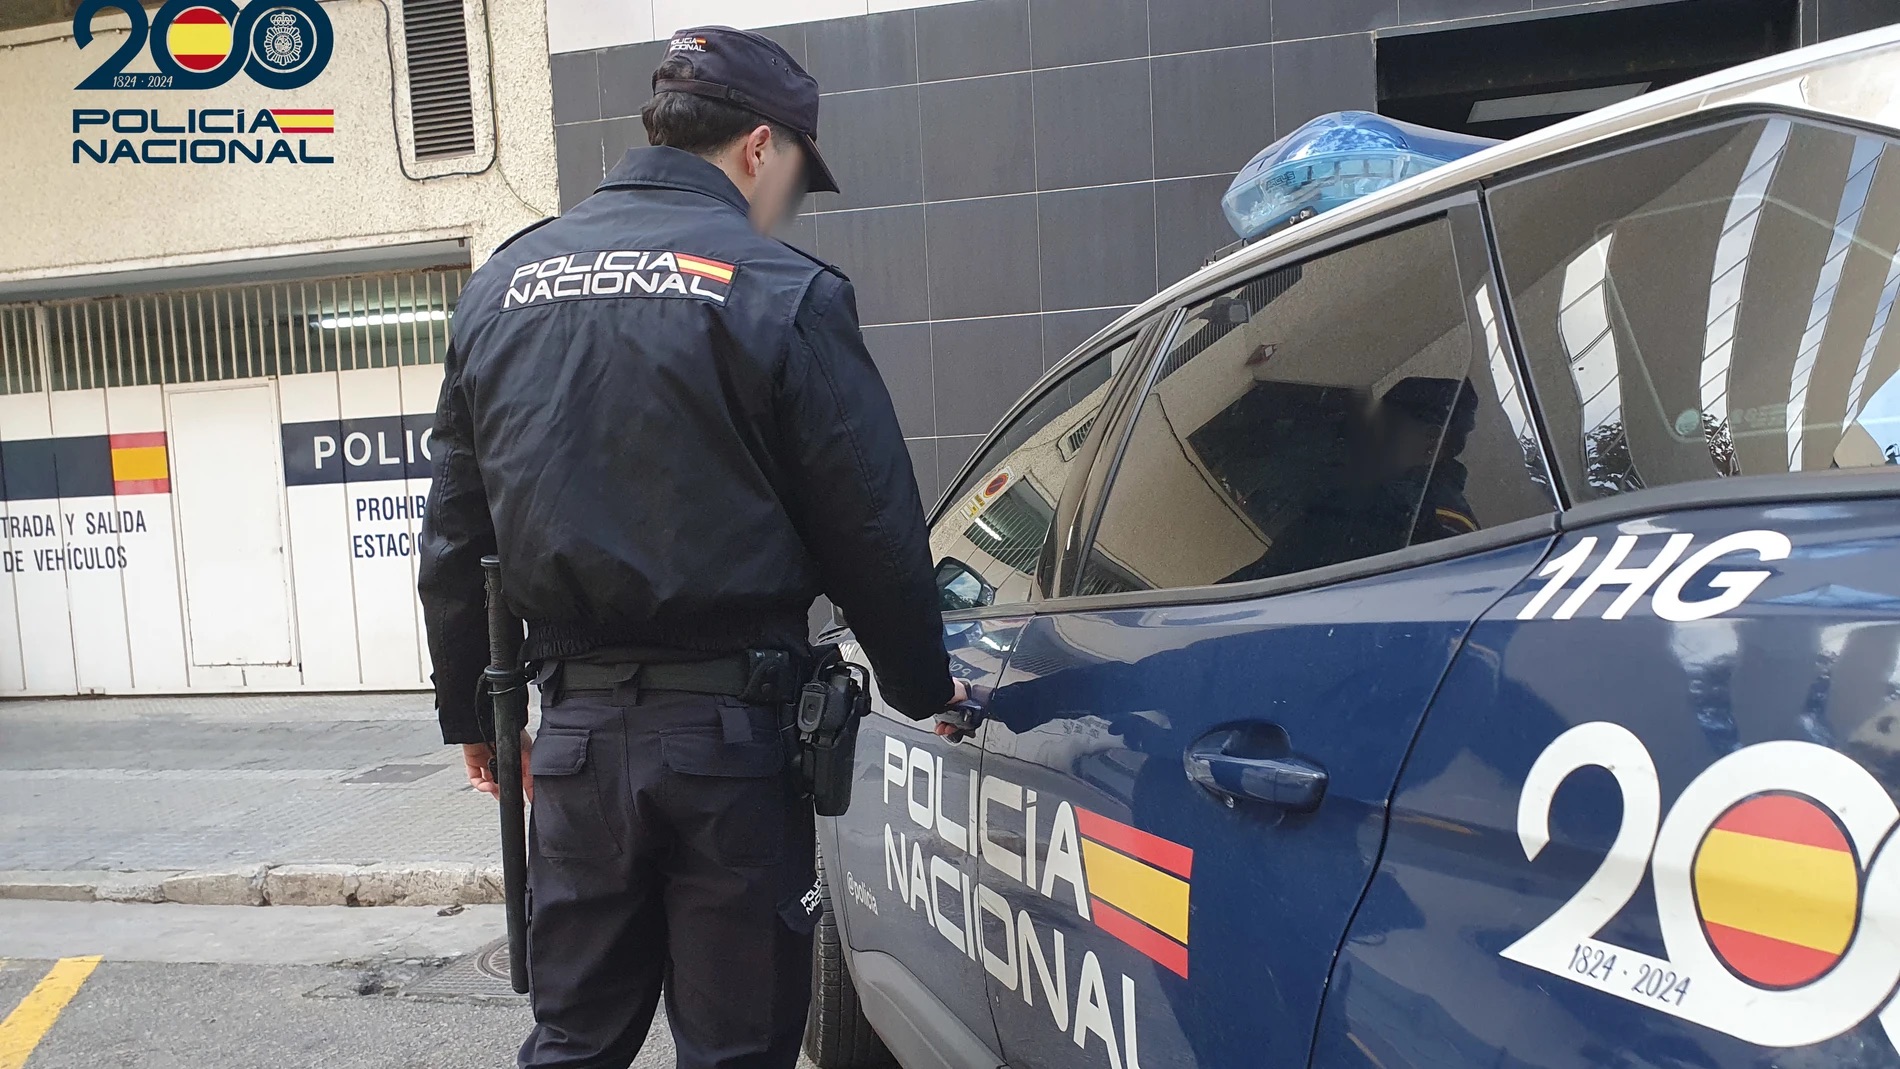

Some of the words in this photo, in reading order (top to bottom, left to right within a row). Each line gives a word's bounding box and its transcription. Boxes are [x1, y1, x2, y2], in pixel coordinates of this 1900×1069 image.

[503, 272, 724, 308] NACIONAL
[0, 514, 55, 538] TRADA
[65, 513, 75, 536] Y
[86, 510, 147, 535] SALIDA
[356, 495, 427, 521] PROHIB
[3, 550, 24, 573] DE
[34, 541, 127, 572] VEHÍCULOS
[1516, 529, 1792, 622] 1HG
[1499, 721, 1900, 1058] 20
[885, 823, 1141, 1069] NACIONAL
[1568, 943, 1616, 981] 1824
[1631, 964, 1692, 1007] 2024
